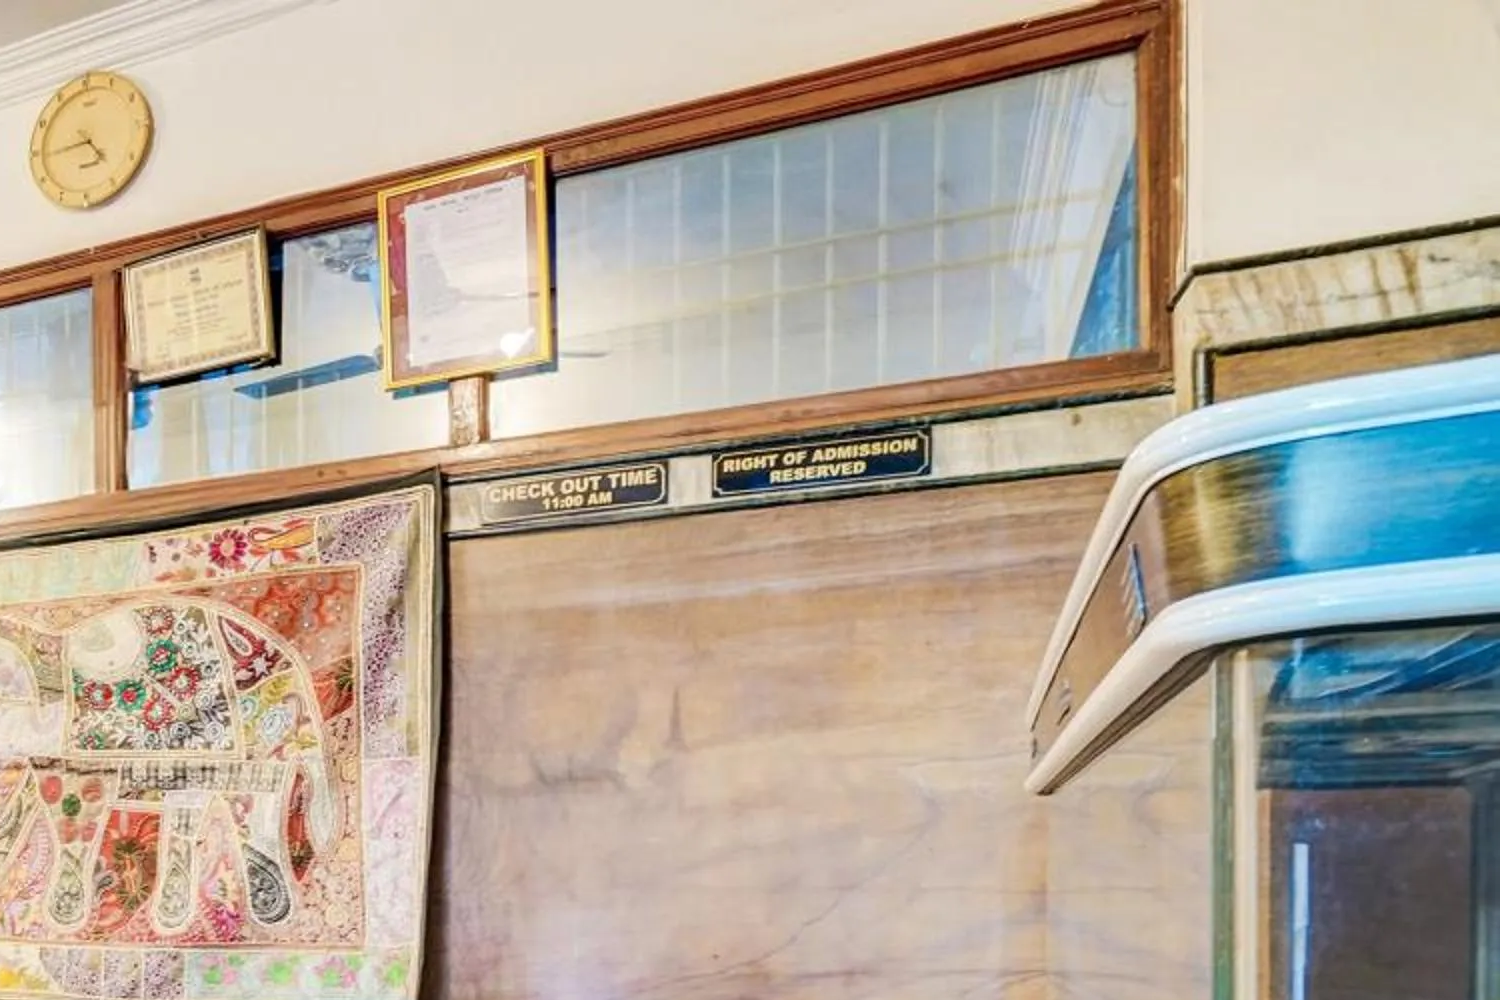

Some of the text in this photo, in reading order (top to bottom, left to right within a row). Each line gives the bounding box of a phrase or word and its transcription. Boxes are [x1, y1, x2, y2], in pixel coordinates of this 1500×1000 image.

[723, 438, 918, 473] RIGHT OF ADMISSION
[489, 469, 658, 503] CHECK OUT TIME
[769, 460, 867, 484] RESERVED
[542, 491, 613, 511] 11:00 AM
